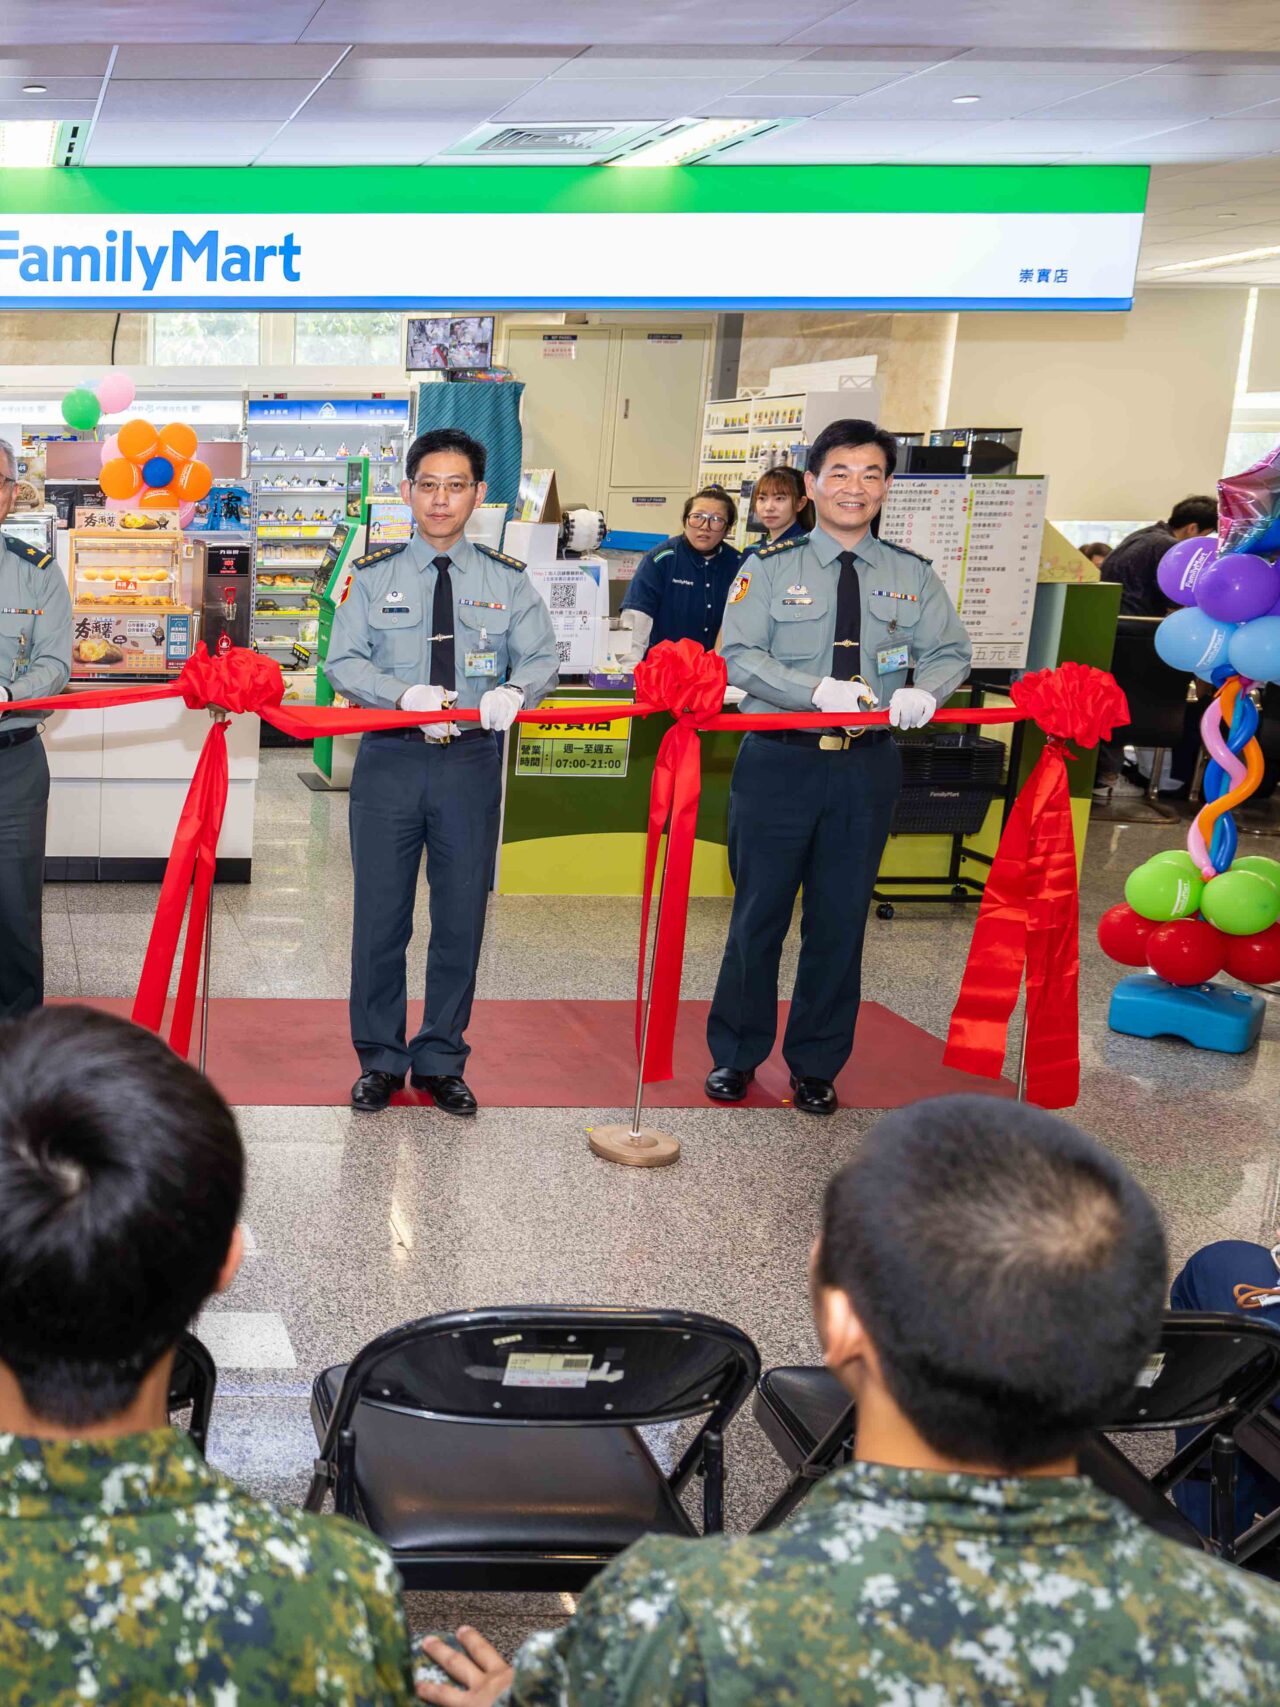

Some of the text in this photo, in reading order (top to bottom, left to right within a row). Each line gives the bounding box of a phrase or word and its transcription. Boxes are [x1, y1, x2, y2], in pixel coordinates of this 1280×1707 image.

[1185, 551, 1208, 589] FamilyMart
[521, 745, 541, 755] 營業
[563, 744, 614, 754] 週一至週五
[520, 757, 540, 767] 時間
[555, 759, 621, 769] 07:00-21:00
